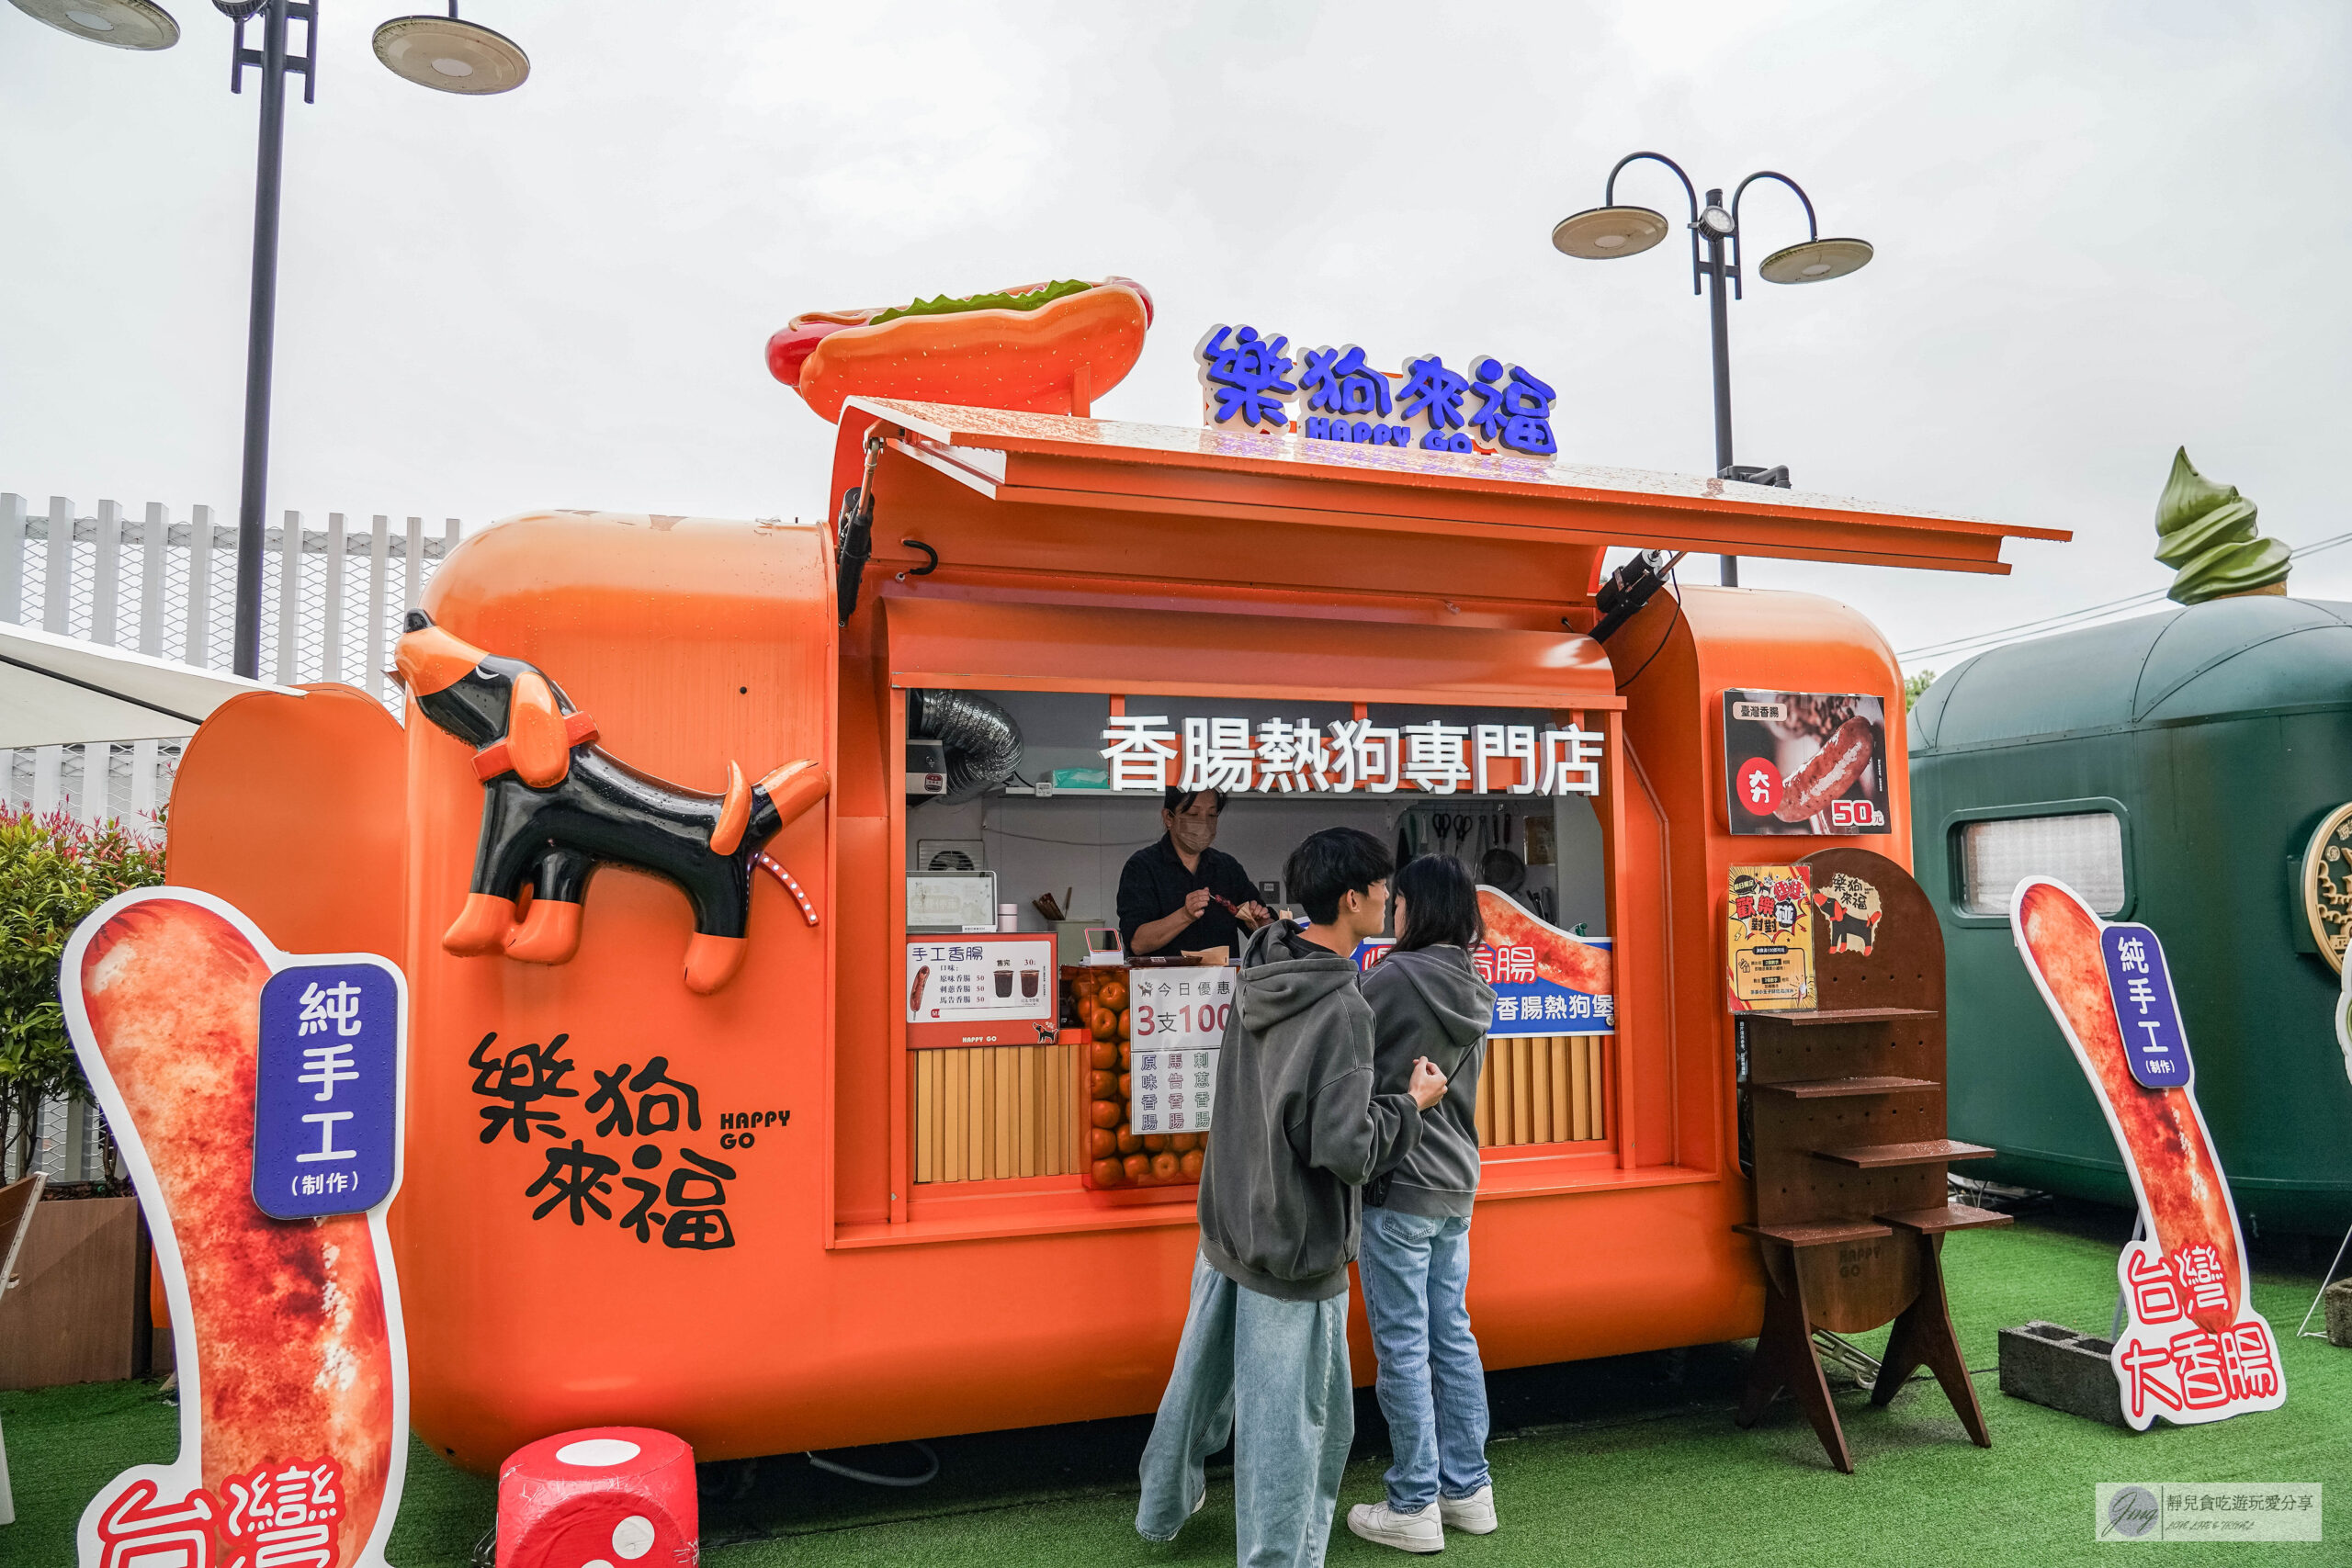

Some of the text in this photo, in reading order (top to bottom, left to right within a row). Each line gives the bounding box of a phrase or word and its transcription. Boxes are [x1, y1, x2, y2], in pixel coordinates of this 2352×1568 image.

[1202, 325, 1558, 457] 樂狗來福
[1306, 416, 1474, 455] HAPPY GO
[1099, 714, 1606, 797] 香腸熱狗專門店
[911, 946, 983, 962] 手工香腸
[939, 975, 971, 983] 原味香腸
[1158, 980, 1231, 998] 今日優惠
[1496, 994, 1615, 1021] 香腸熱狗堡
[2117, 936, 2169, 1054] 純手工
[296, 980, 363, 1165] 純手工
[468, 1032, 702, 1145] 樂狗
[1141, 1054, 1158, 1131] 原味香腸
[1168, 1053, 1184, 1130] 馬告香腸
[719, 1132, 755, 1150] GO
[720, 1110, 791, 1130] HAPPY
[290, 1170, 360, 1197] (制作)
[525, 1139, 737, 1251] 來福
[2131, 1245, 2229, 1325] 台灣
[2122, 1323, 2278, 1417] 大香腸
